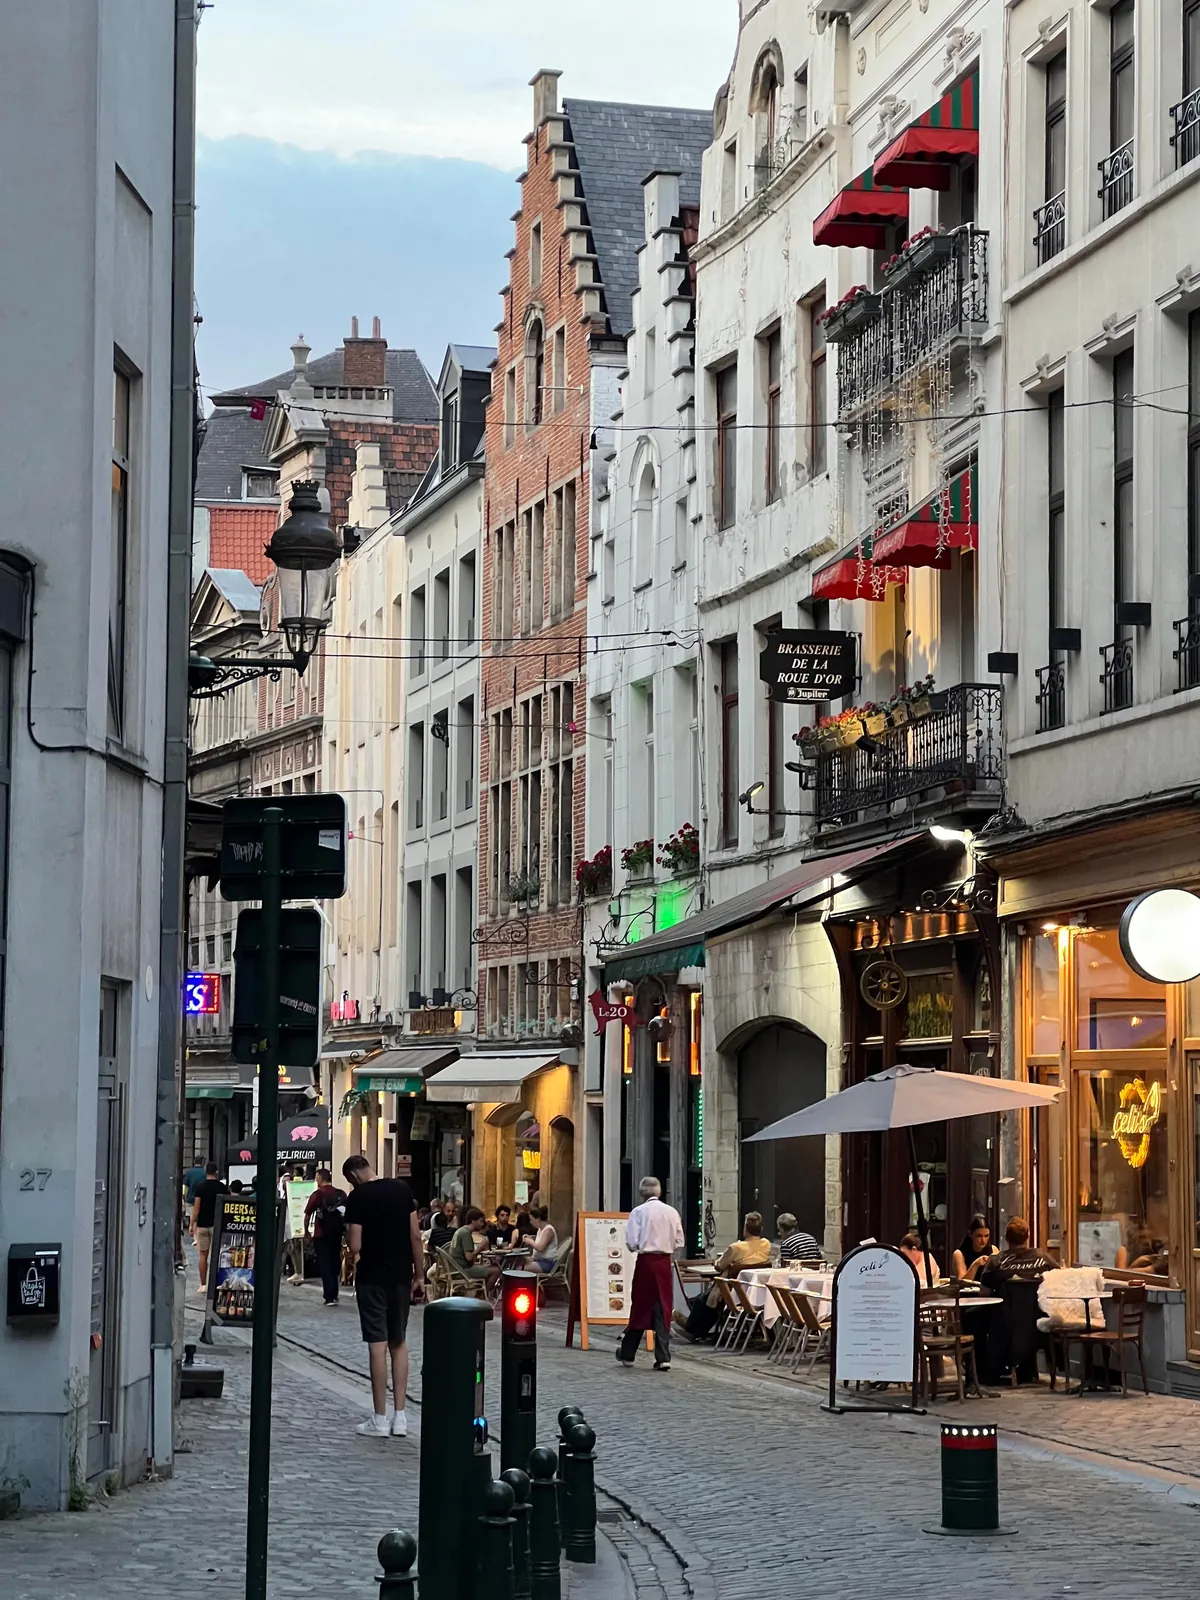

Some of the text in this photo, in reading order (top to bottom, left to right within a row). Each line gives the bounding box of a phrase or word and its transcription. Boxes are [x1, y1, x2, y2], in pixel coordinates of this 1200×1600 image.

[777, 643, 842, 656] BRASSERIE
[791, 658, 828, 670] DE LA
[776, 672, 842, 685] ROUE D'OR
[797, 689, 828, 699] Jupiler
[20, 1168, 52, 1191] 27
